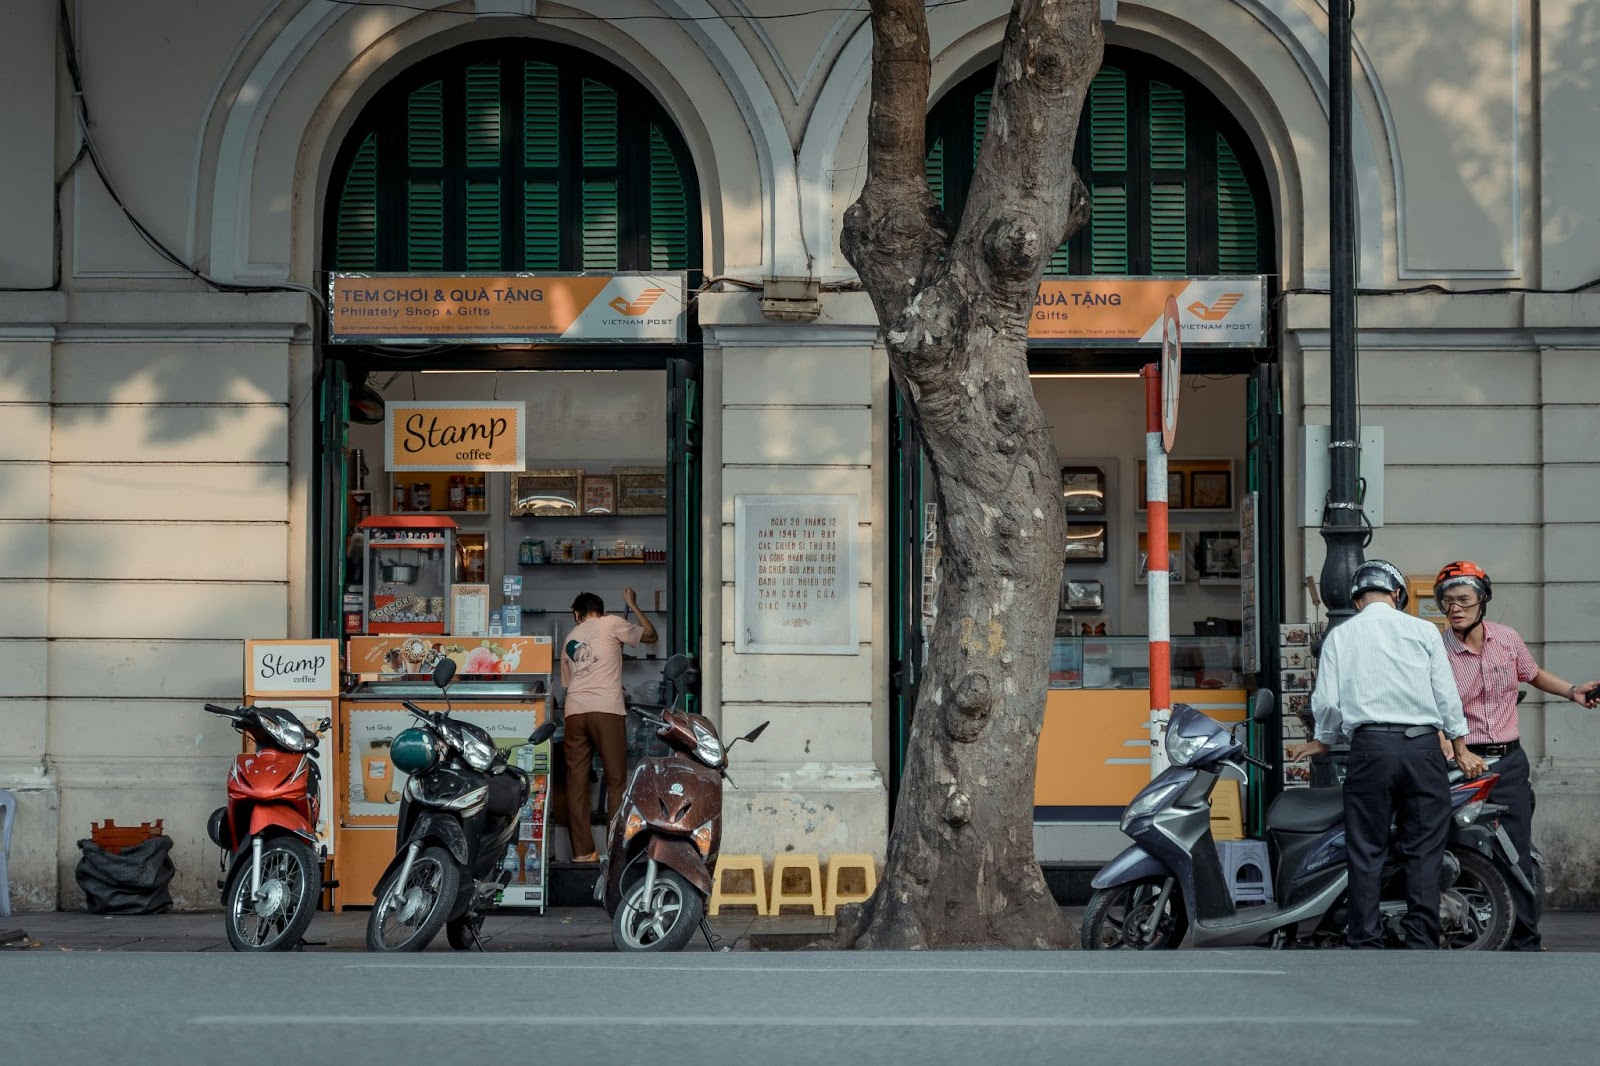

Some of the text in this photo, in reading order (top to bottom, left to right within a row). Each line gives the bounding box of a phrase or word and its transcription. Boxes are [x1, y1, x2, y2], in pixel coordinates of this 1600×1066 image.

[341, 286, 543, 304] TEM CHƠI & QUÀ TẶNG
[1071, 290, 1121, 308] TẶNG
[341, 306, 491, 318] Philately Shop & Gifts
[1035, 310, 1069, 320] Gifts
[403, 413, 507, 453] Stamp
[455, 448, 491, 460] coffee
[790, 517, 800, 527] 20
[829, 517, 836, 527] 12
[394, 531, 442, 540] POPCORN
[779, 529, 797, 539] 1946
[458, 587, 482, 596] Stamp
[370, 594, 416, 621] POPCORN
[261, 653, 325, 679] Stamp
[293, 675, 316, 683] coffee
